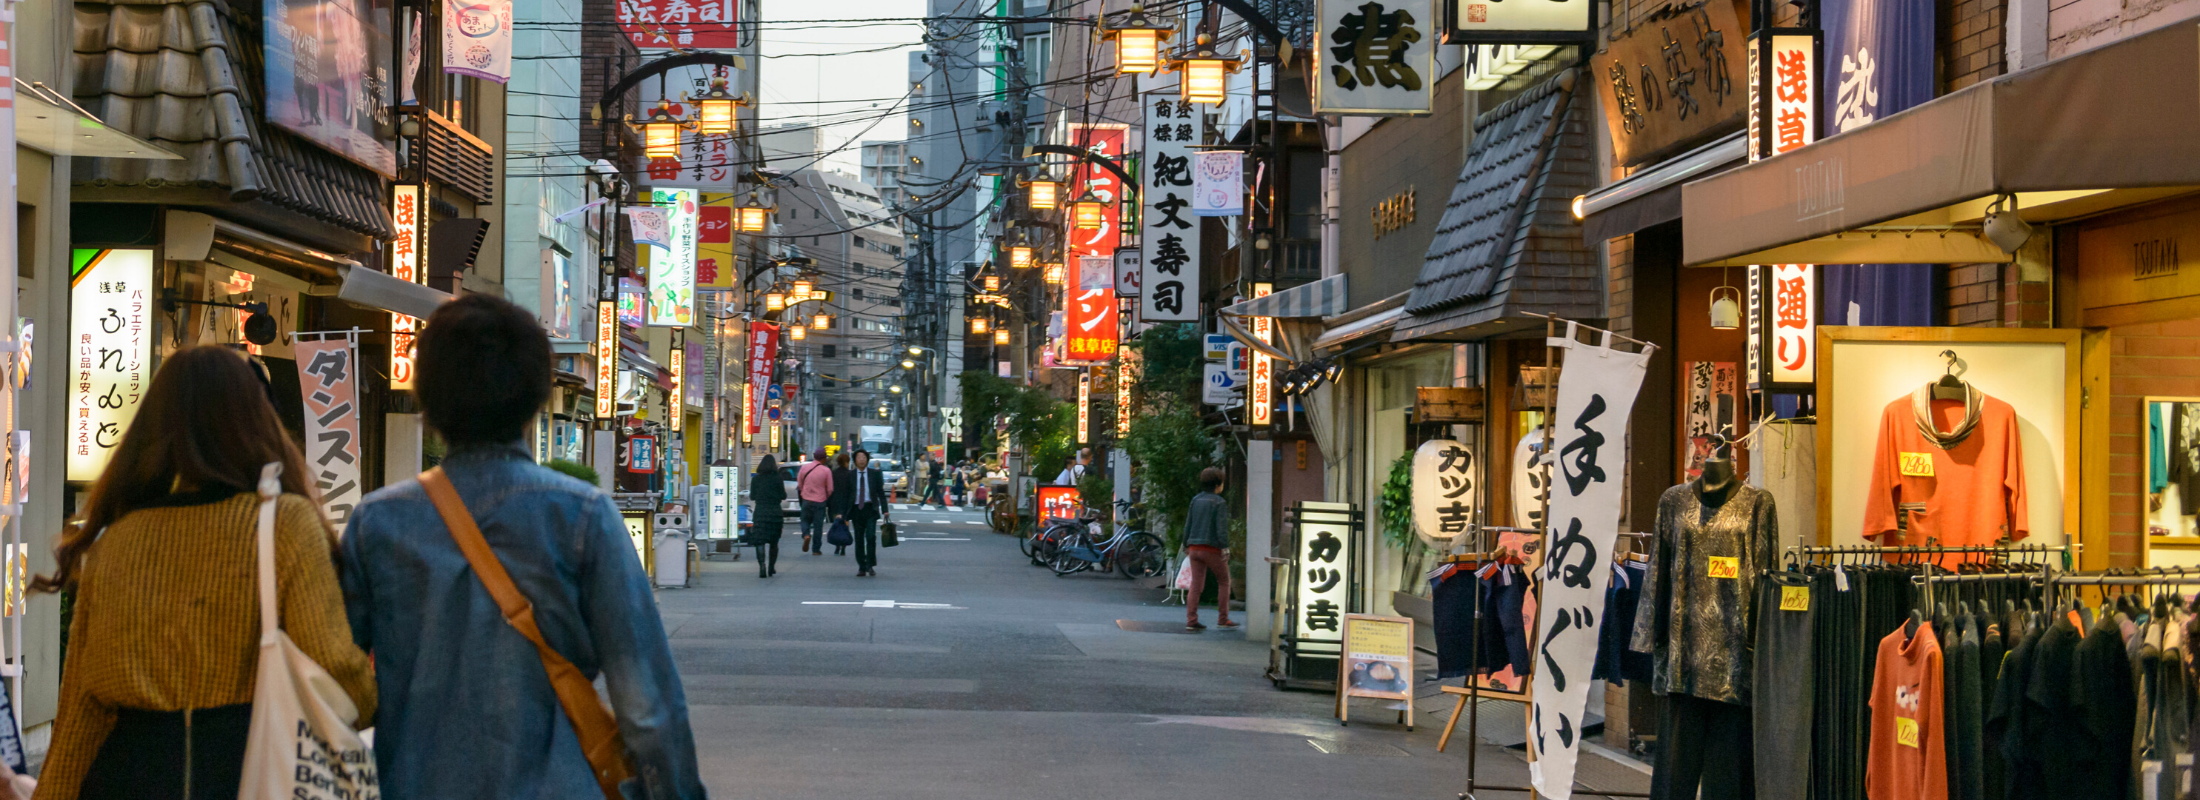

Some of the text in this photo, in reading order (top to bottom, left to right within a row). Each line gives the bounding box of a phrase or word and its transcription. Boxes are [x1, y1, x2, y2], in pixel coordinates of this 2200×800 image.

[1152, 98, 1172, 142] 商標
[1174, 99, 1194, 142] 登録
[1749, 48, 1760, 163] ASAKUS
[1795, 156, 1845, 214] TSUTAYA
[99, 281, 127, 294] 浅草
[393, 194, 415, 383] 浅草中通り
[2133, 237, 2179, 276] TSUTAYA
[95, 308, 127, 449] ふれんど
[128, 289, 143, 405] バラエティーショップ
[598, 306, 612, 413] 浅草中央通り
[1069, 337, 1115, 354] 浅草店
[1213, 343, 1227, 351] VIS
[77, 333, 92, 456] 良い品が安く買える店
[1436, 445, 1472, 533] カツ吉
[1902, 454, 1932, 476] 2980
[1305, 531, 1342, 632] カツ吉
[1536, 393, 1606, 756] 手ぬぐい
[1709, 559, 1736, 578] 2500
